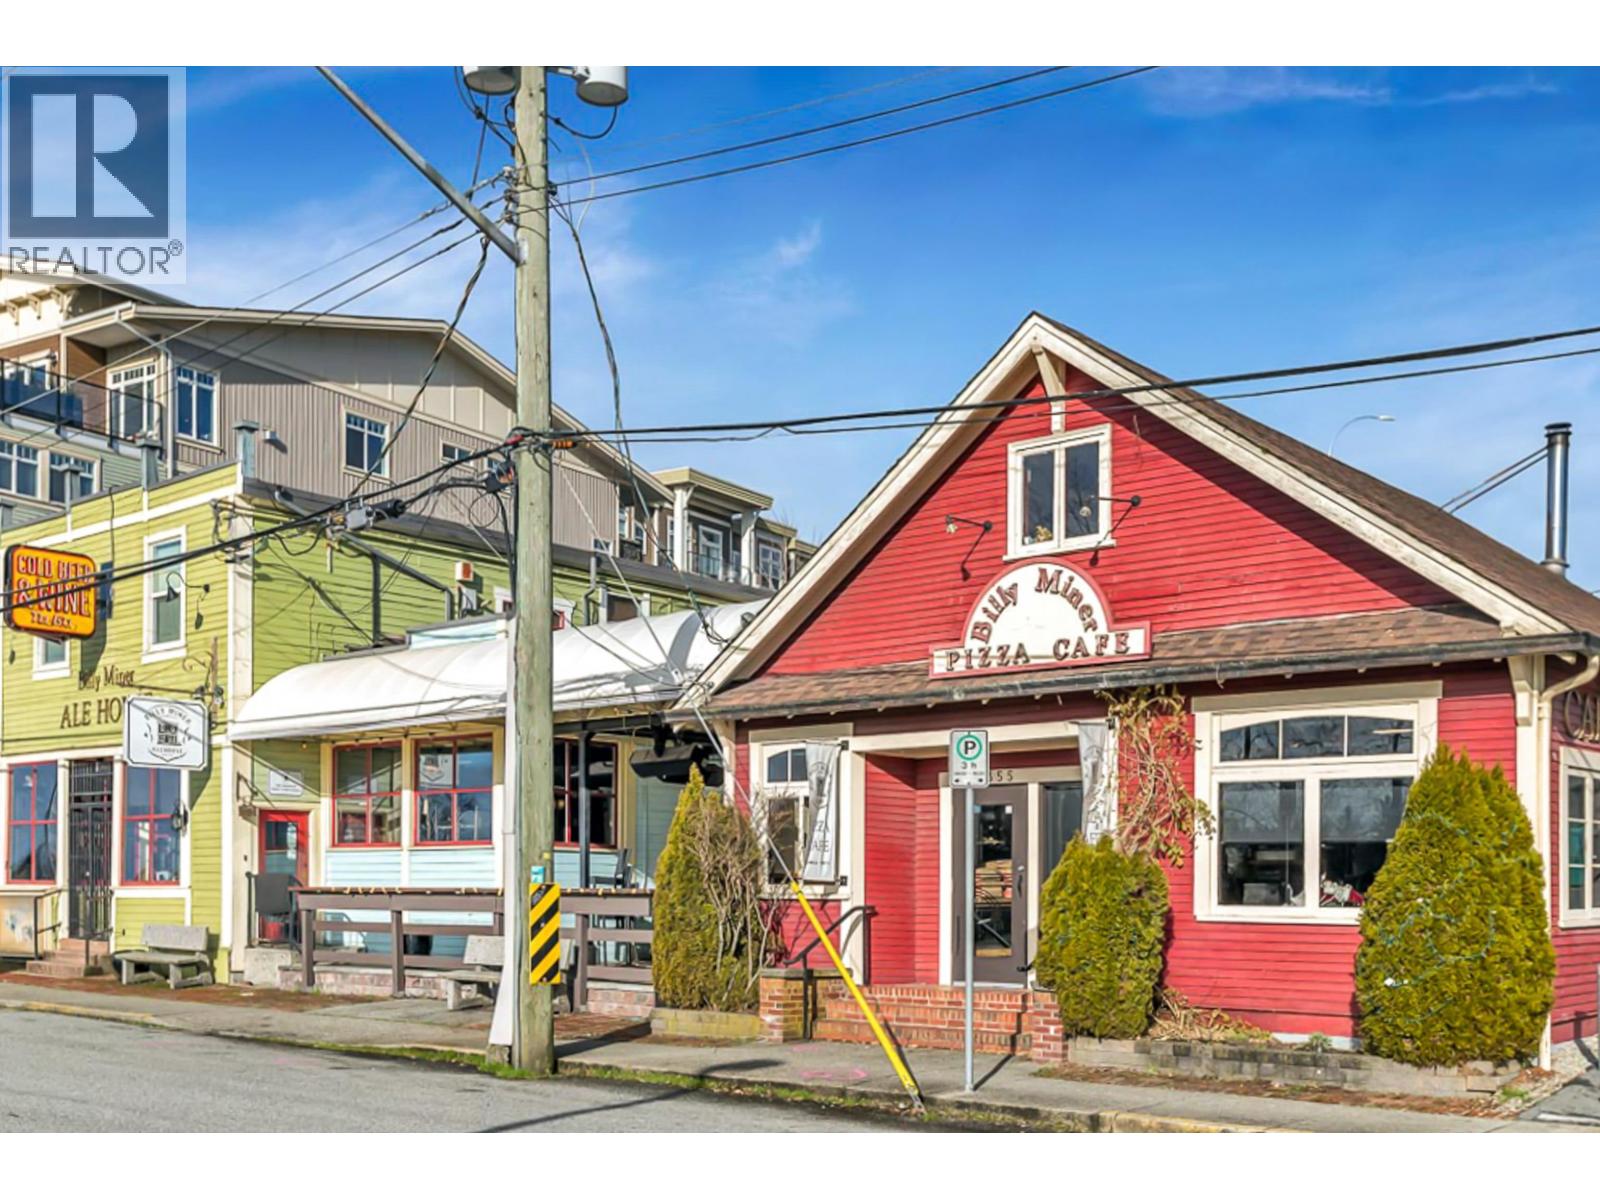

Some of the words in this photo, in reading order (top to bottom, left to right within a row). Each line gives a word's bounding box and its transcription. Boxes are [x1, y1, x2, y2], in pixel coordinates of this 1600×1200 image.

[18, 555, 53, 578] COLD
[36, 579, 91, 618] WINE
[970, 582, 1019, 645] Billy
[1034, 566, 1098, 634] Miner
[945, 642, 1031, 671] PIZZA
[1052, 632, 1130, 661] CAFE
[103, 664, 135, 687] Miner
[60, 700, 91, 729] ALE
[964, 740, 976, 755] P
